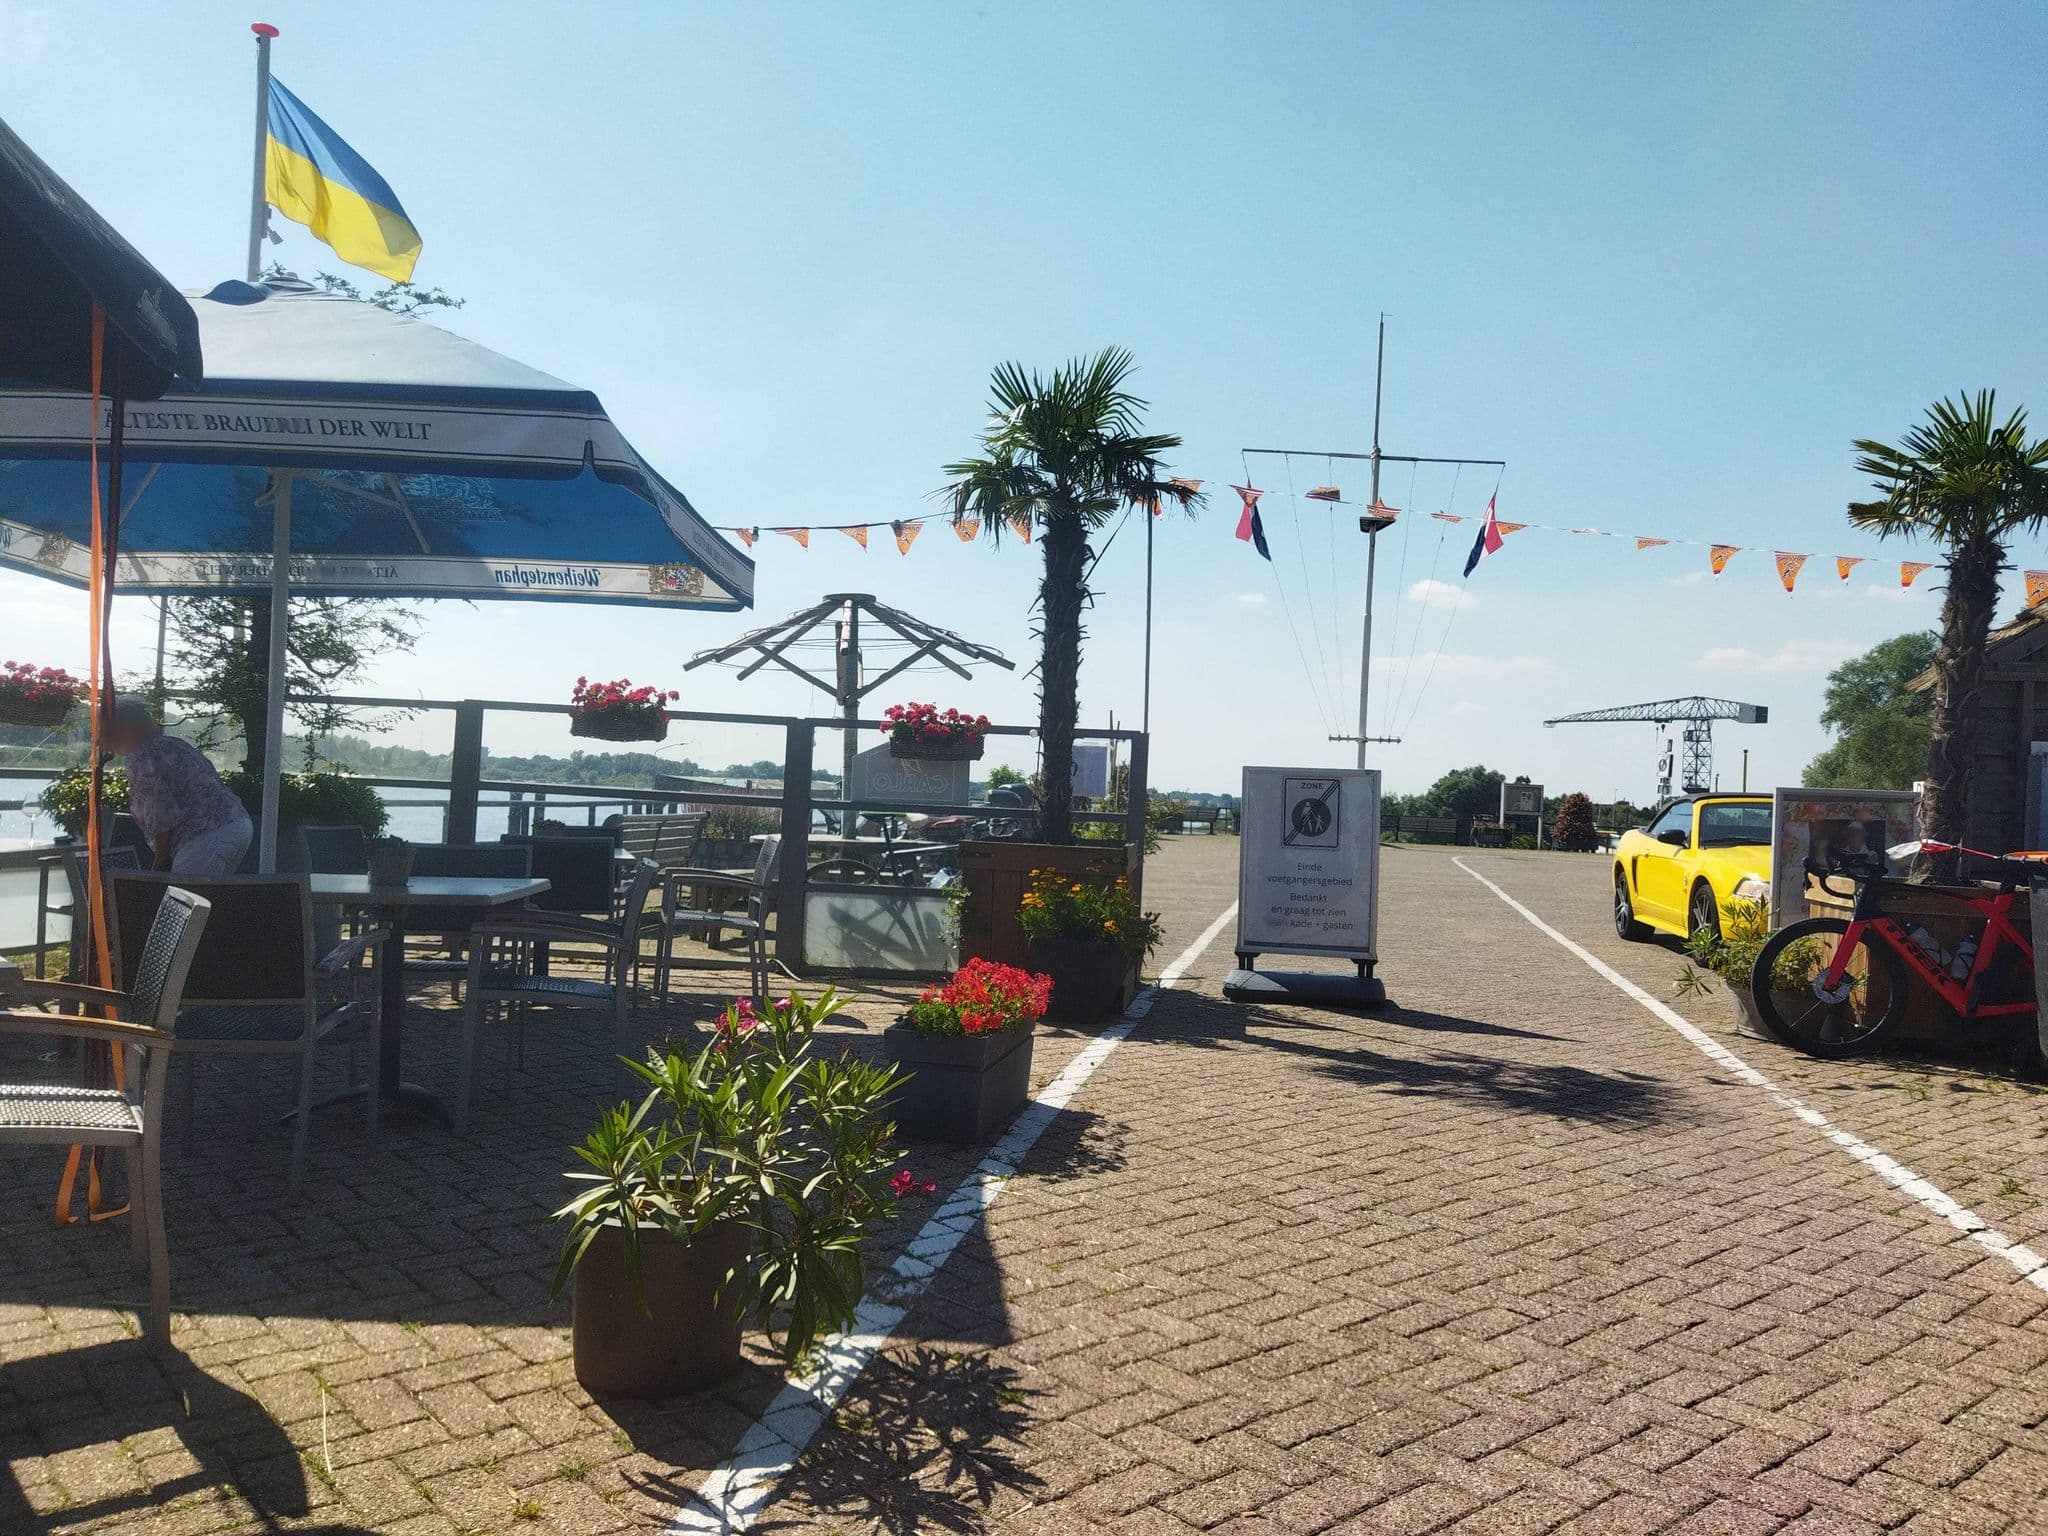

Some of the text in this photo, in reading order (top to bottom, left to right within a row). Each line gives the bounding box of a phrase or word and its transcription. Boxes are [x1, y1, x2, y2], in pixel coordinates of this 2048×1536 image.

[318, 418, 368, 437] DER
[368, 420, 432, 441] WELT
[1300, 782, 1324, 790] ZONE
[1297, 862, 1323, 872] Einde
[1267, 875, 1352, 886] voetgangersgebied
[1290, 892, 1328, 903] Bedankt
[1271, 905, 1347, 917] en graag tot zien
[1290, 919, 1313, 929] kade
[1322, 921, 1354, 931] gasten
